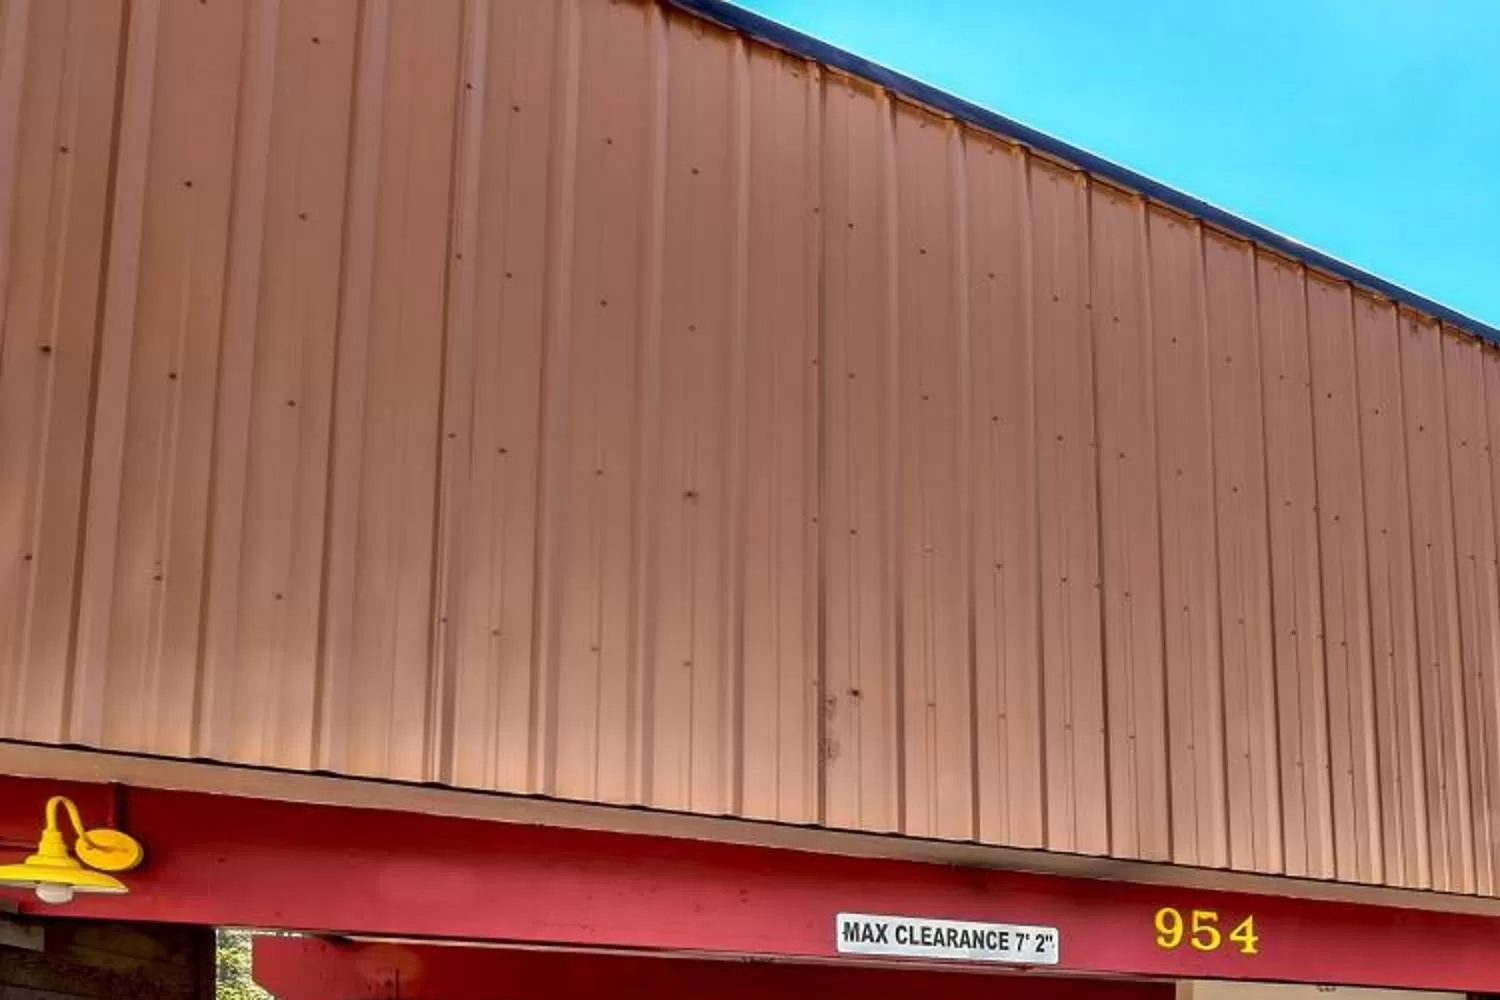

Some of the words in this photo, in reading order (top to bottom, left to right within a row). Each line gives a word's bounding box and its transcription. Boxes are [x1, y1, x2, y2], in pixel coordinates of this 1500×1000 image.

[842, 921, 888, 945] MAX
[895, 925, 1009, 951] CLEARANCE
[1015, 933, 1030, 953] 7'
[1154, 907, 1259, 954] 954
